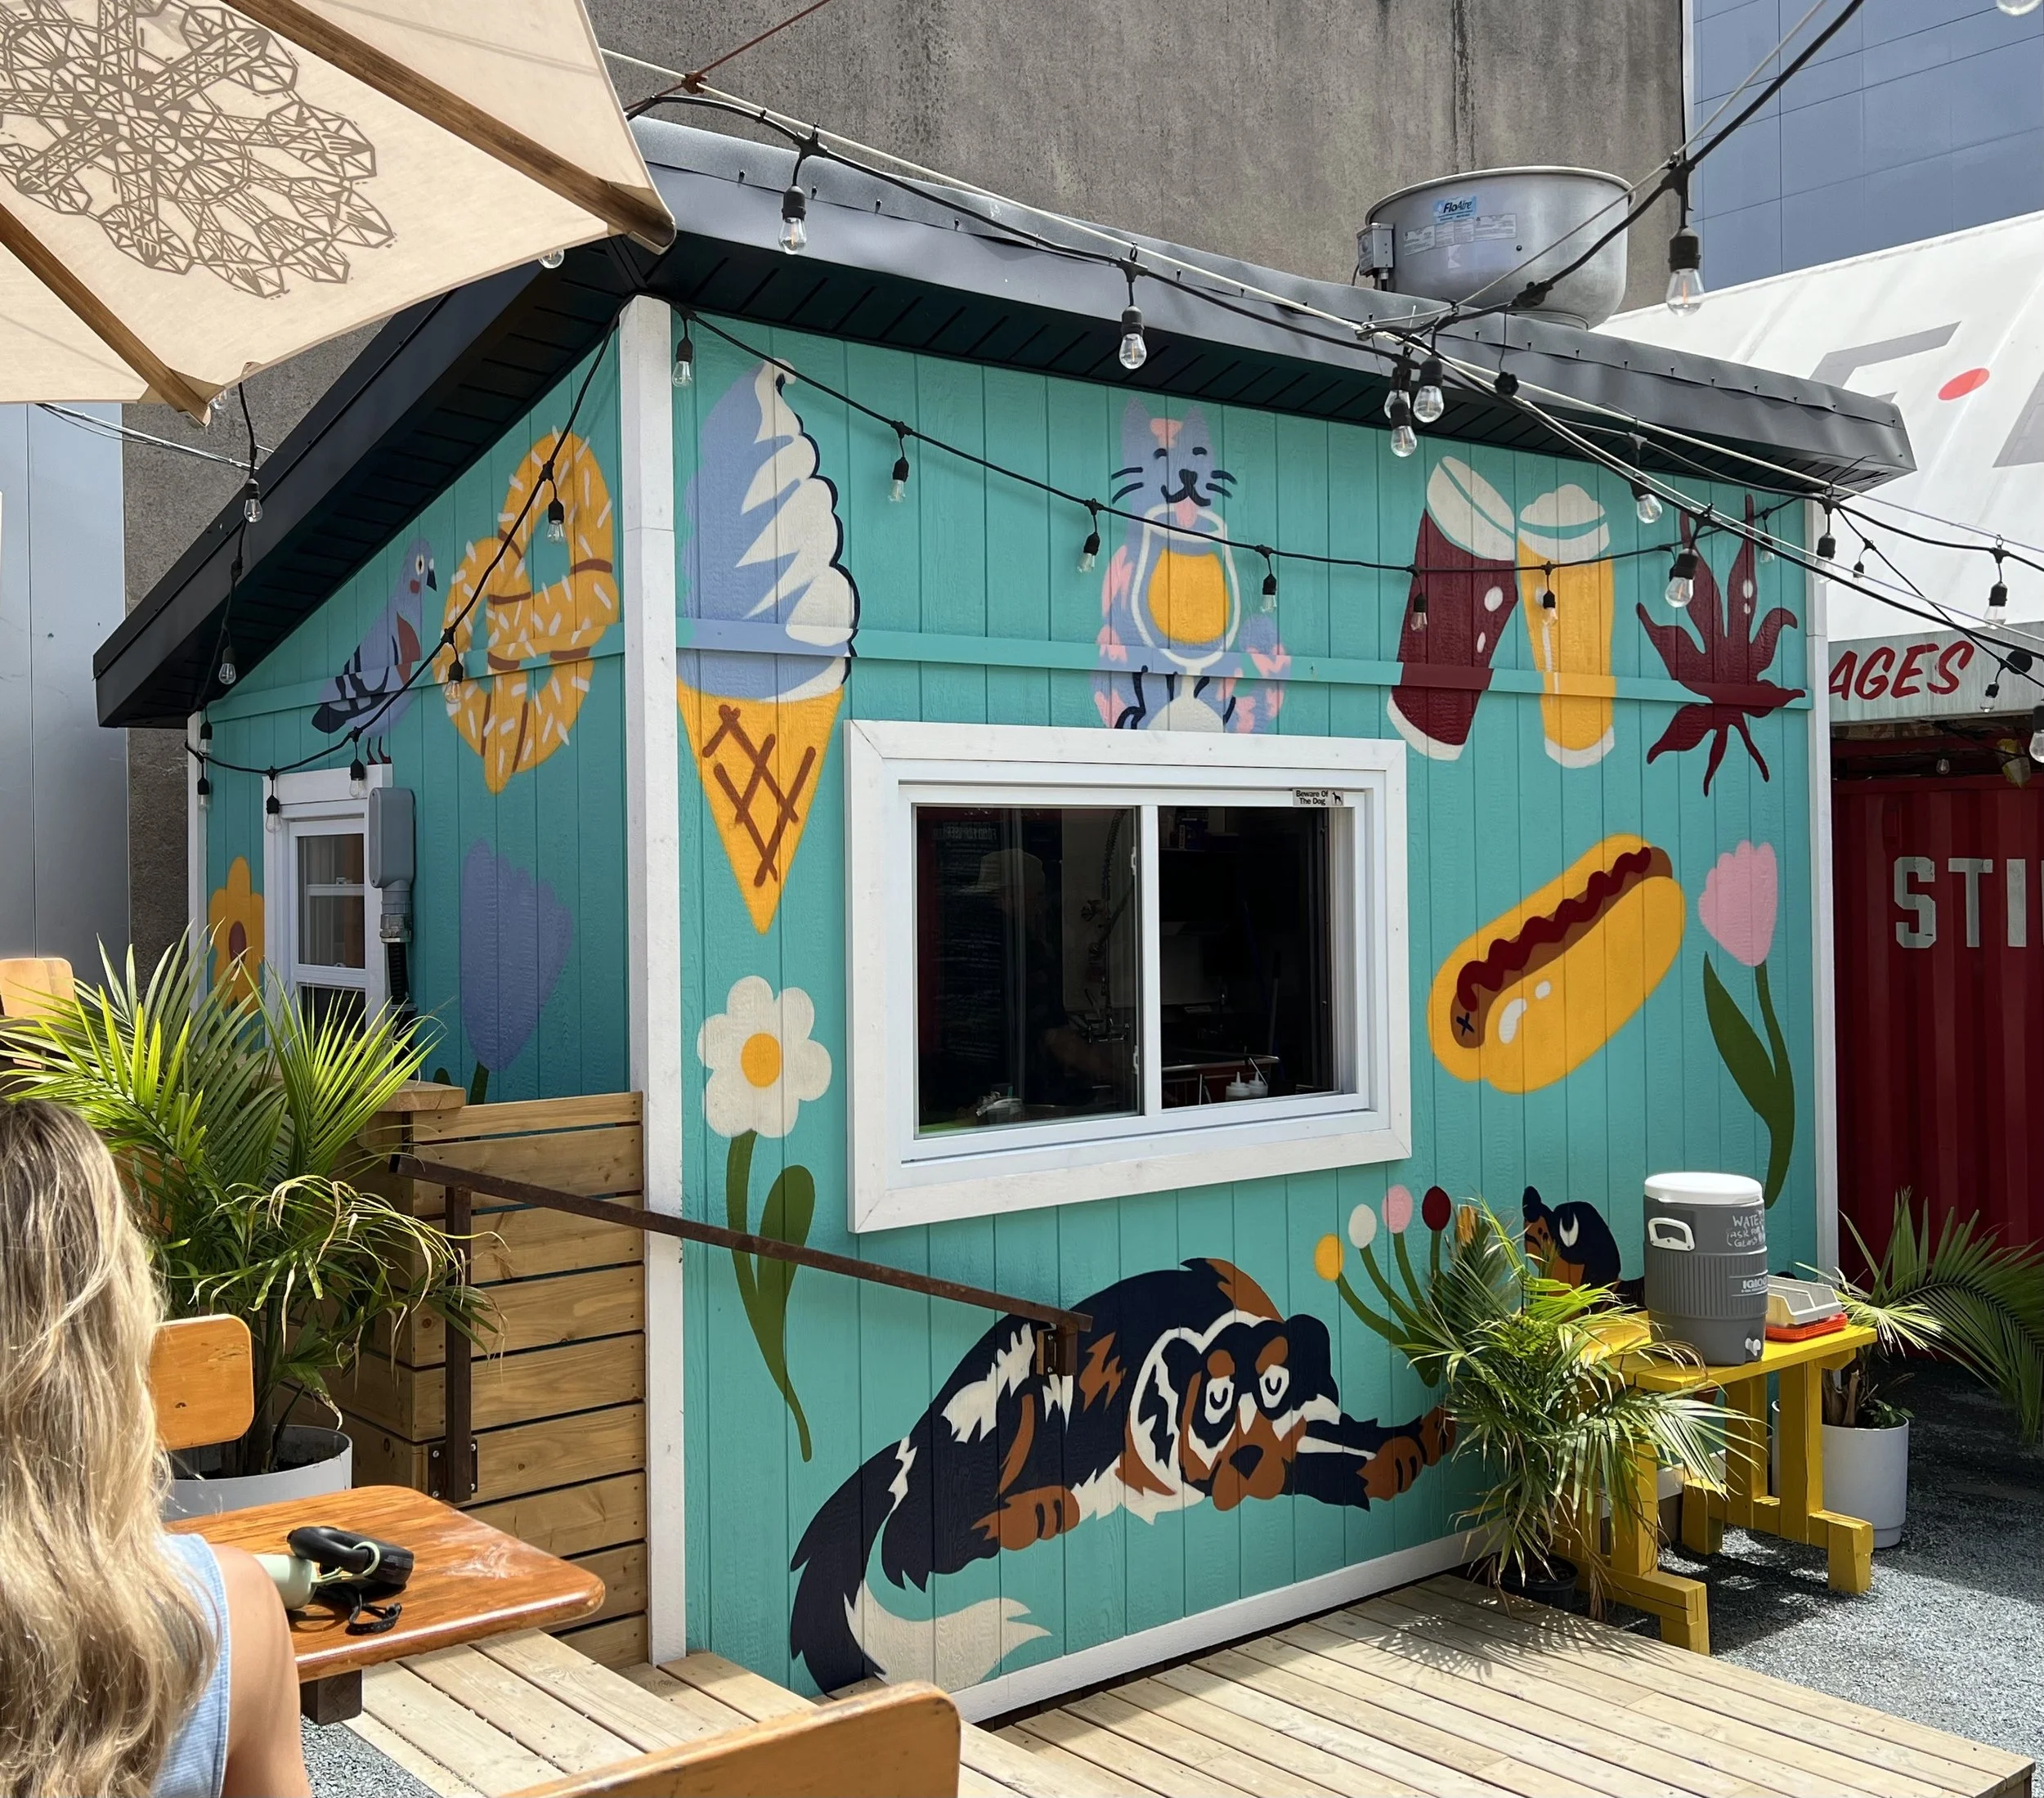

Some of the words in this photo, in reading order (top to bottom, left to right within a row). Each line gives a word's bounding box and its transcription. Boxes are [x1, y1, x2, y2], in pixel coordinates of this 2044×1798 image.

[1443, 200, 1472, 213] FloAire
[1828, 640, 1975, 701] AGES
[1894, 856, 2044, 948] STI
[1742, 1276, 1767, 1289] IGLOO
